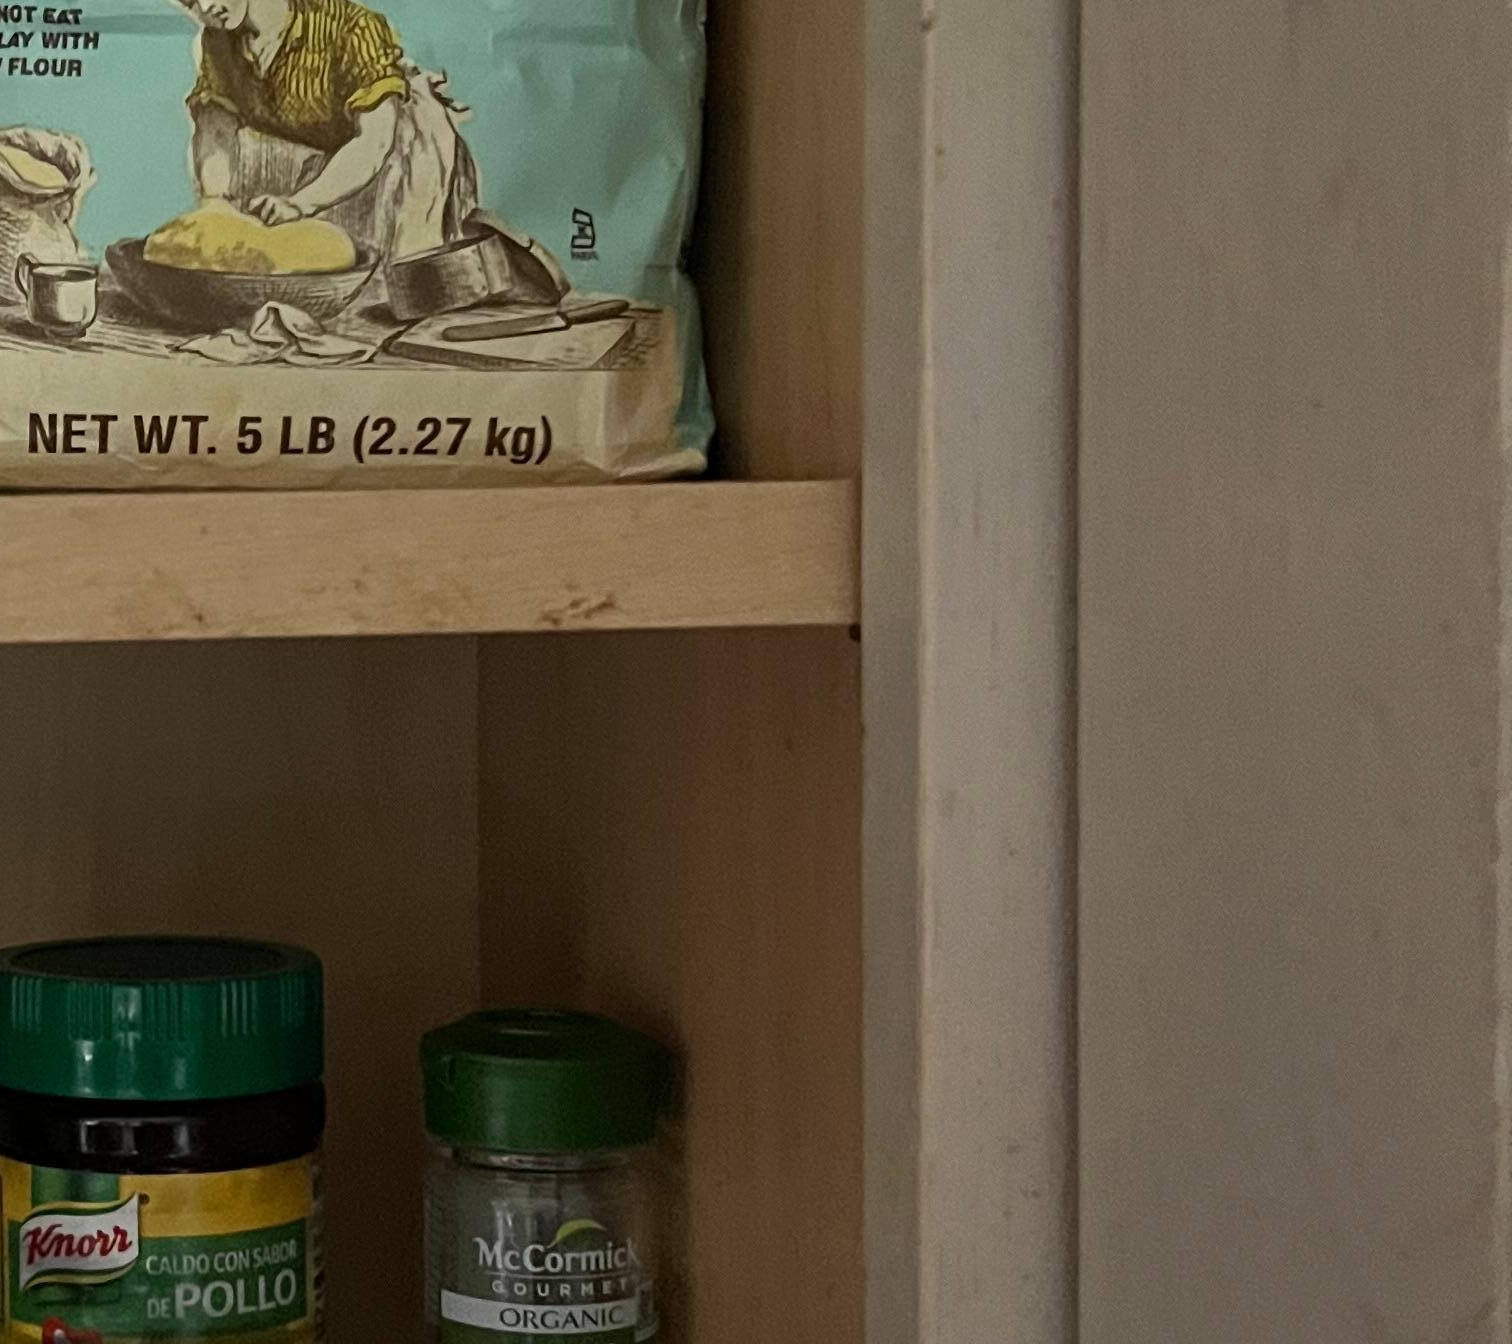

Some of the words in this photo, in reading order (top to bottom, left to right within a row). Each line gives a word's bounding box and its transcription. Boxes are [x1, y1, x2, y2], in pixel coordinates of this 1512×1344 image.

[42, 8, 84, 25] EAT
[40, 31, 100, 51] WITH
[8, 59, 83, 78] FLOUR
[26, 413, 117, 455] NET
[133, 416, 217, 457] WT.
[236, 416, 263, 455] 5
[279, 416, 335, 456] LB
[352, 415, 472, 464] (2.27
[486, 415, 553, 466] kg)
[22, 1224, 134, 1265] Knorr
[145, 1251, 209, 1277] CALDO
[213, 1249, 251, 1272] CON
[252, 1239, 298, 1269] SABOR
[472, 1237, 640, 1273] McCormick
[147, 1296, 171, 1319] DE
[174, 1268, 298, 1319] POLLO
[492, 1278, 628, 1297] GOURMET
[500, 1307, 624, 1330] ORGANIC
